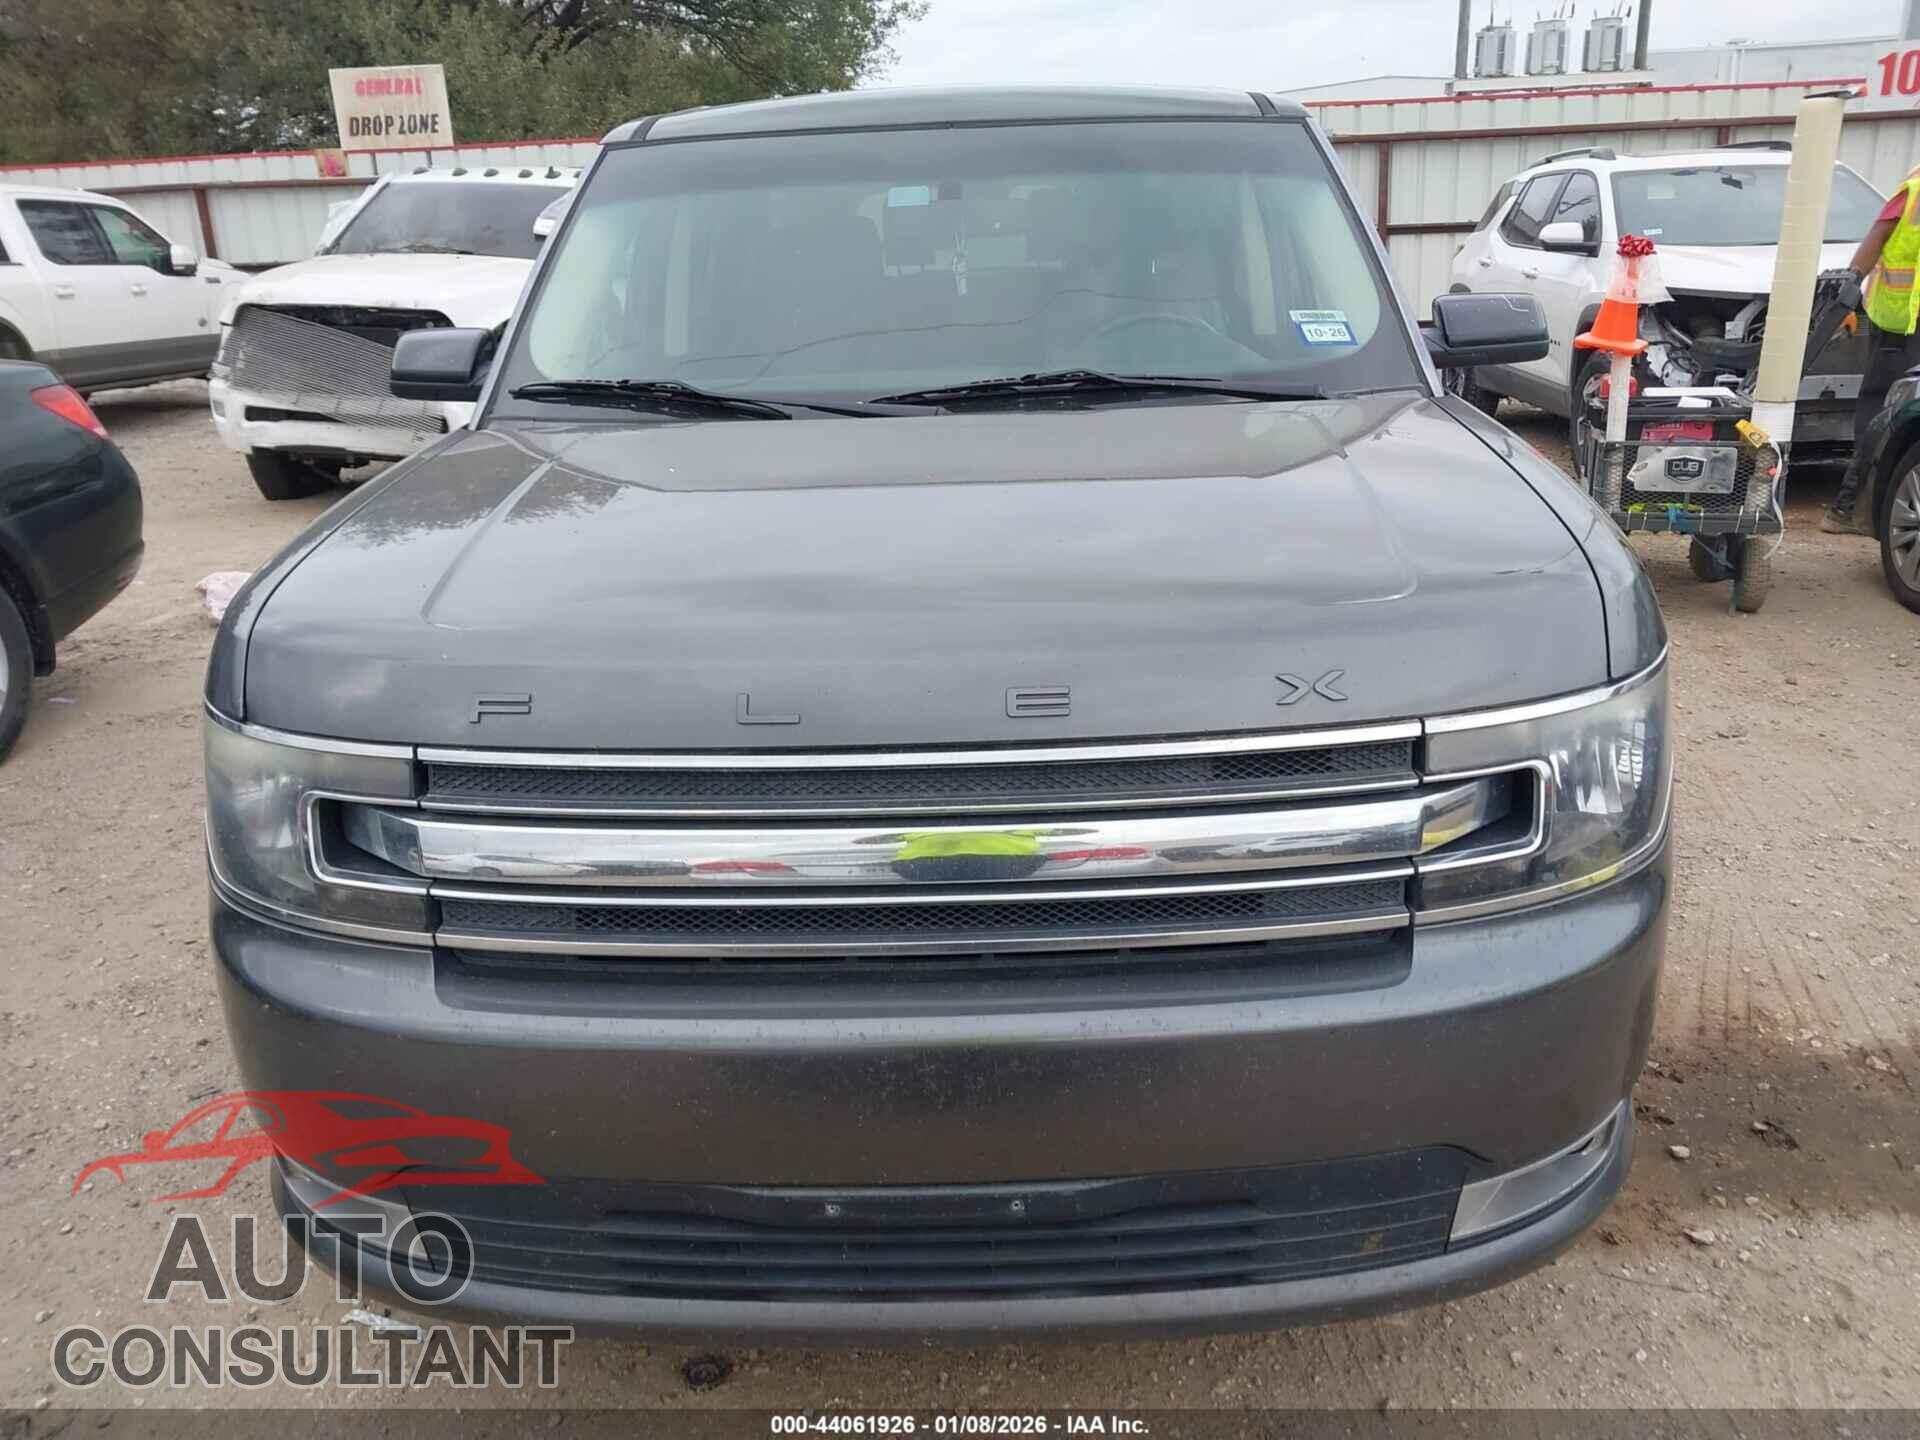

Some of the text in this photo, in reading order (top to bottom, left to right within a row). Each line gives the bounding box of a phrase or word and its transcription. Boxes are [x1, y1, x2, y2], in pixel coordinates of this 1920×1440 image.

[354, 77, 422, 96] GENERAL
[349, 114, 440, 137] DROP ZONE
[468, 669, 1349, 725] FLEX
